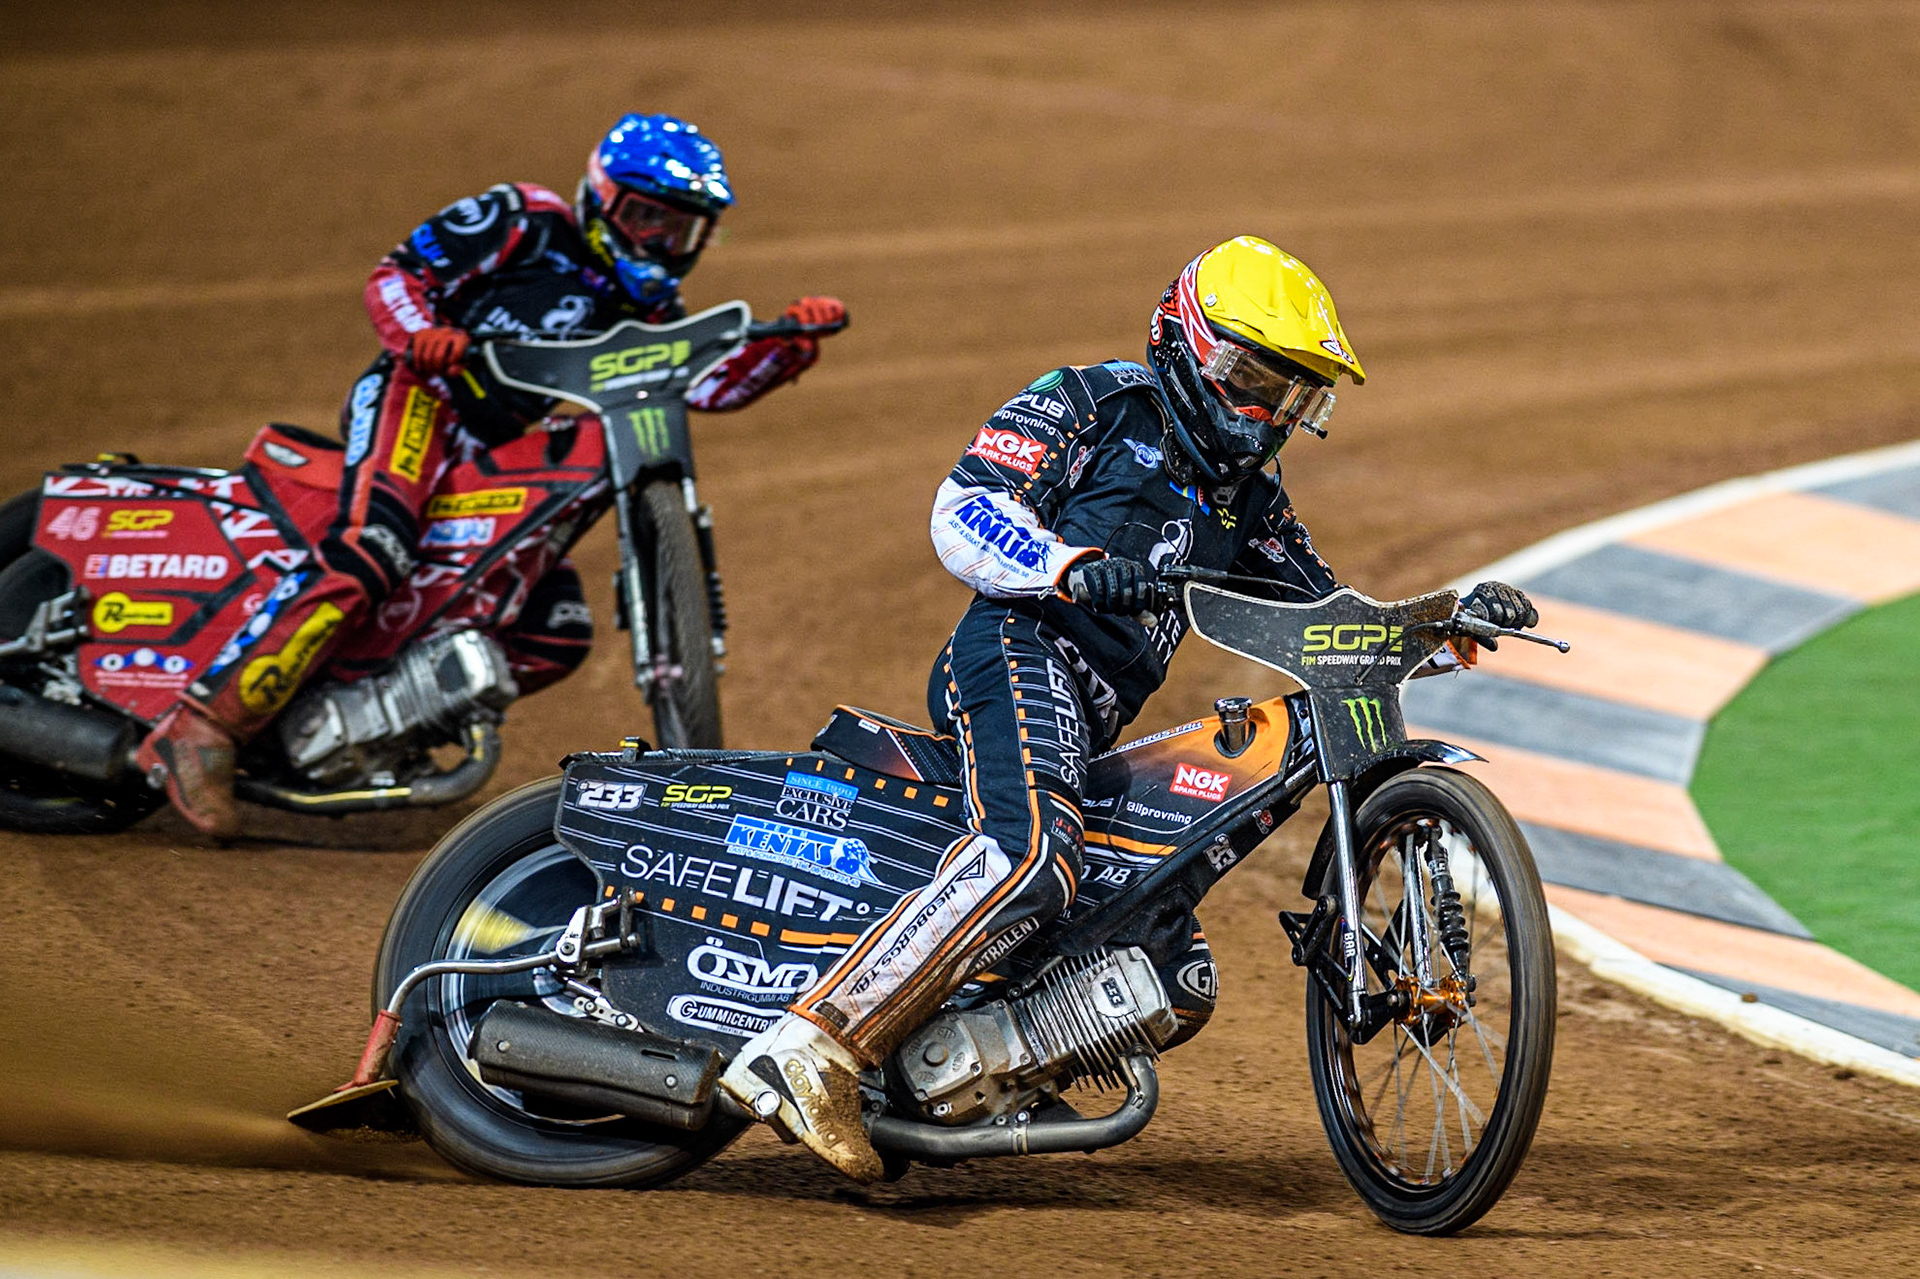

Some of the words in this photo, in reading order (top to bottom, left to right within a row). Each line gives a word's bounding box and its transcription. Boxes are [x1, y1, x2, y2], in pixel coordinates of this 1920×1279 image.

[974, 432, 1042, 463] NGK
[1000, 453, 1034, 472] PLUGS
[47, 507, 100, 541] 46
[106, 509, 174, 531] SGP
[109, 554, 228, 579] BETARD
[1301, 655, 1316, 667] FIM
[1317, 655, 1359, 666] SPEEDWAY
[1386, 655, 1402, 667] PRIX
[1047, 658, 1081, 789] SAFELIFT
[1176, 766, 1230, 793] NGK
[662, 785, 733, 804] SGP
[781, 786, 854, 810] EXCLUSIVE
[1174, 785, 1197, 797] SPARK
[1198, 789, 1222, 801] PLUGS
[776, 797, 850, 830] CARS
[1126, 801, 1192, 825] Bilprovning
[763, 822, 809, 838] TEAM
[726, 825, 836, 868] KENTAS
[620, 845, 854, 922] SAFELIFT
[1094, 866, 1131, 884] AB
[882, 885, 957, 967] HEDBERGS
[1344, 932, 1355, 958] BAR
